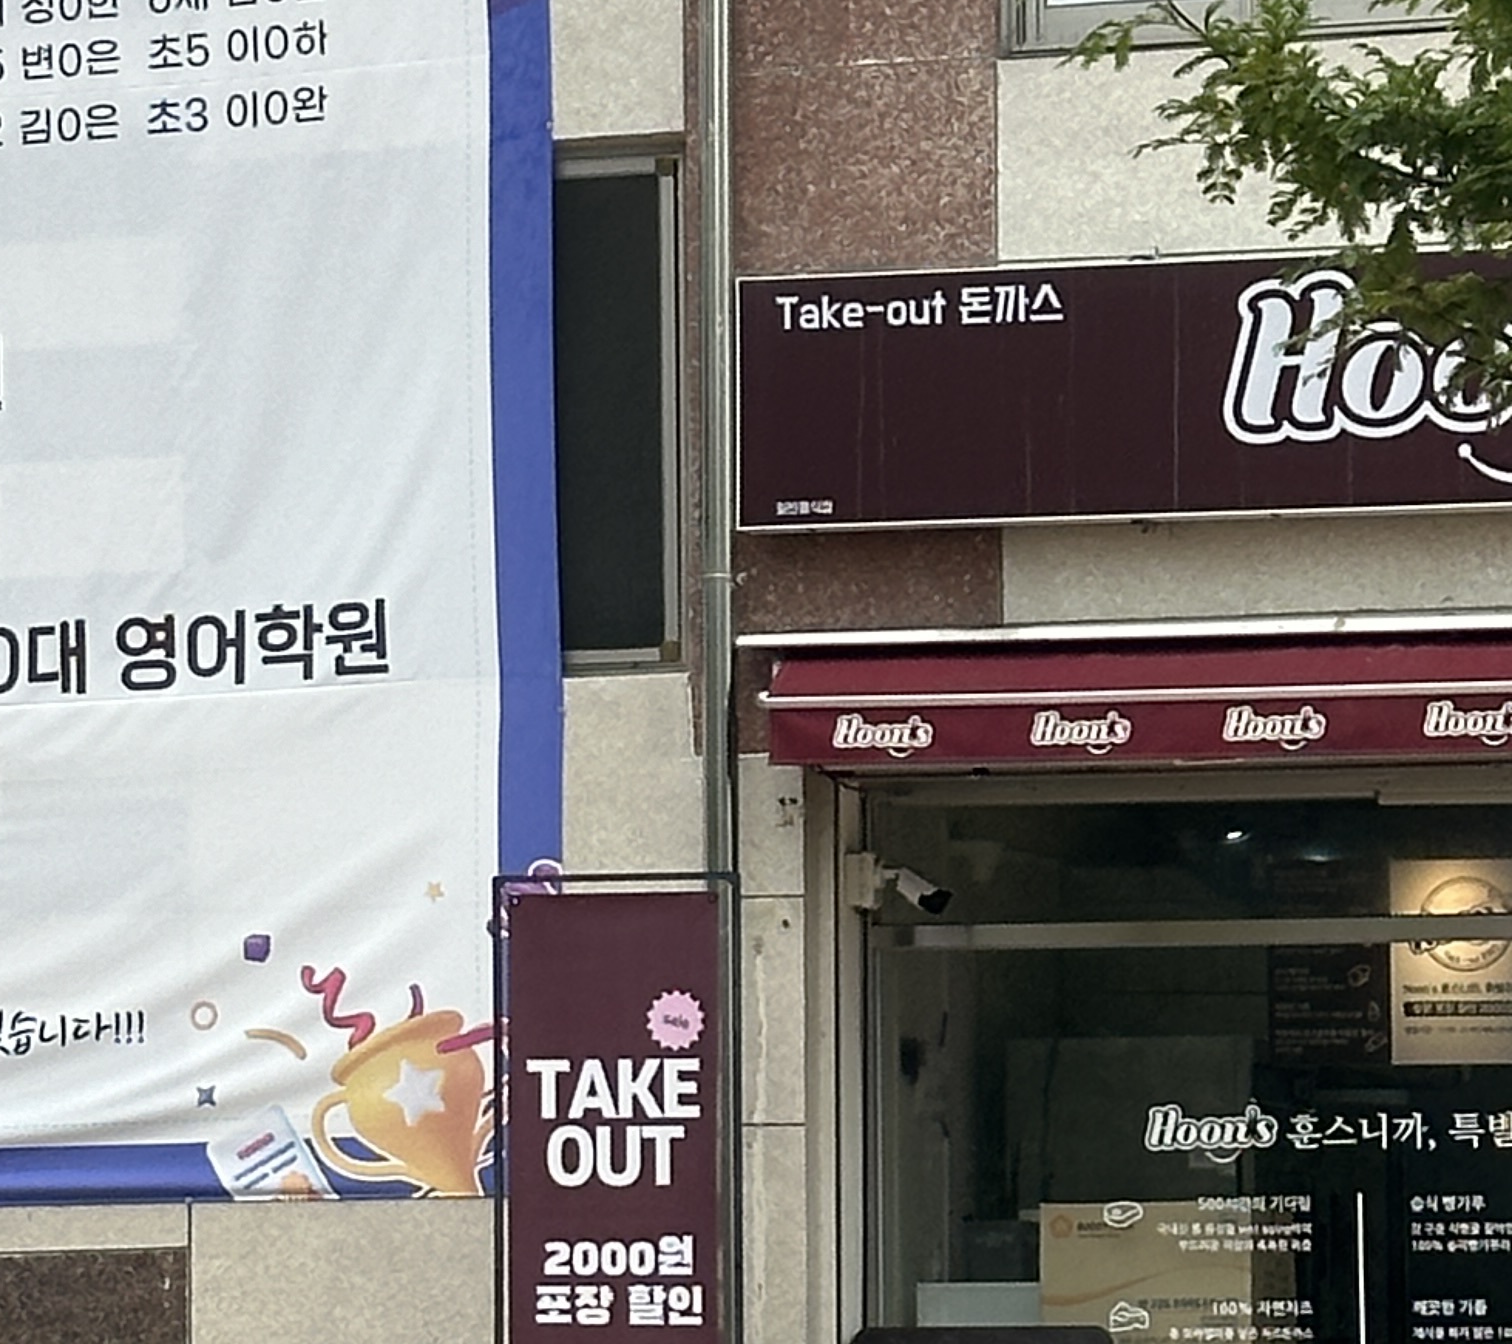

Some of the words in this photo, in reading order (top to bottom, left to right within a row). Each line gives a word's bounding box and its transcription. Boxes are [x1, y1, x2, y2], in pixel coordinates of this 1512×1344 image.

[148, 32, 211, 72] 초5
[147, 96, 210, 136] 초3
[776, 288, 947, 332] Take-out
[958, 283, 1066, 326] 돈까스
[114, 597, 391, 693] 영어학원
[831, 713, 934, 751] Hoon's
[1029, 709, 1133, 747] Hoon's
[1222, 704, 1327, 743] Hoon's
[525, 1057, 702, 1120] TAKE
[1144, 1103, 1279, 1153] Hoon's
[1285, 1110, 1437, 1152] 훈스니까,
[546, 1124, 686, 1189] OUT
[543, 1234, 694, 1278] 2000원
[535, 1283, 615, 1326] 포장
[626, 1283, 705, 1327] 할인
